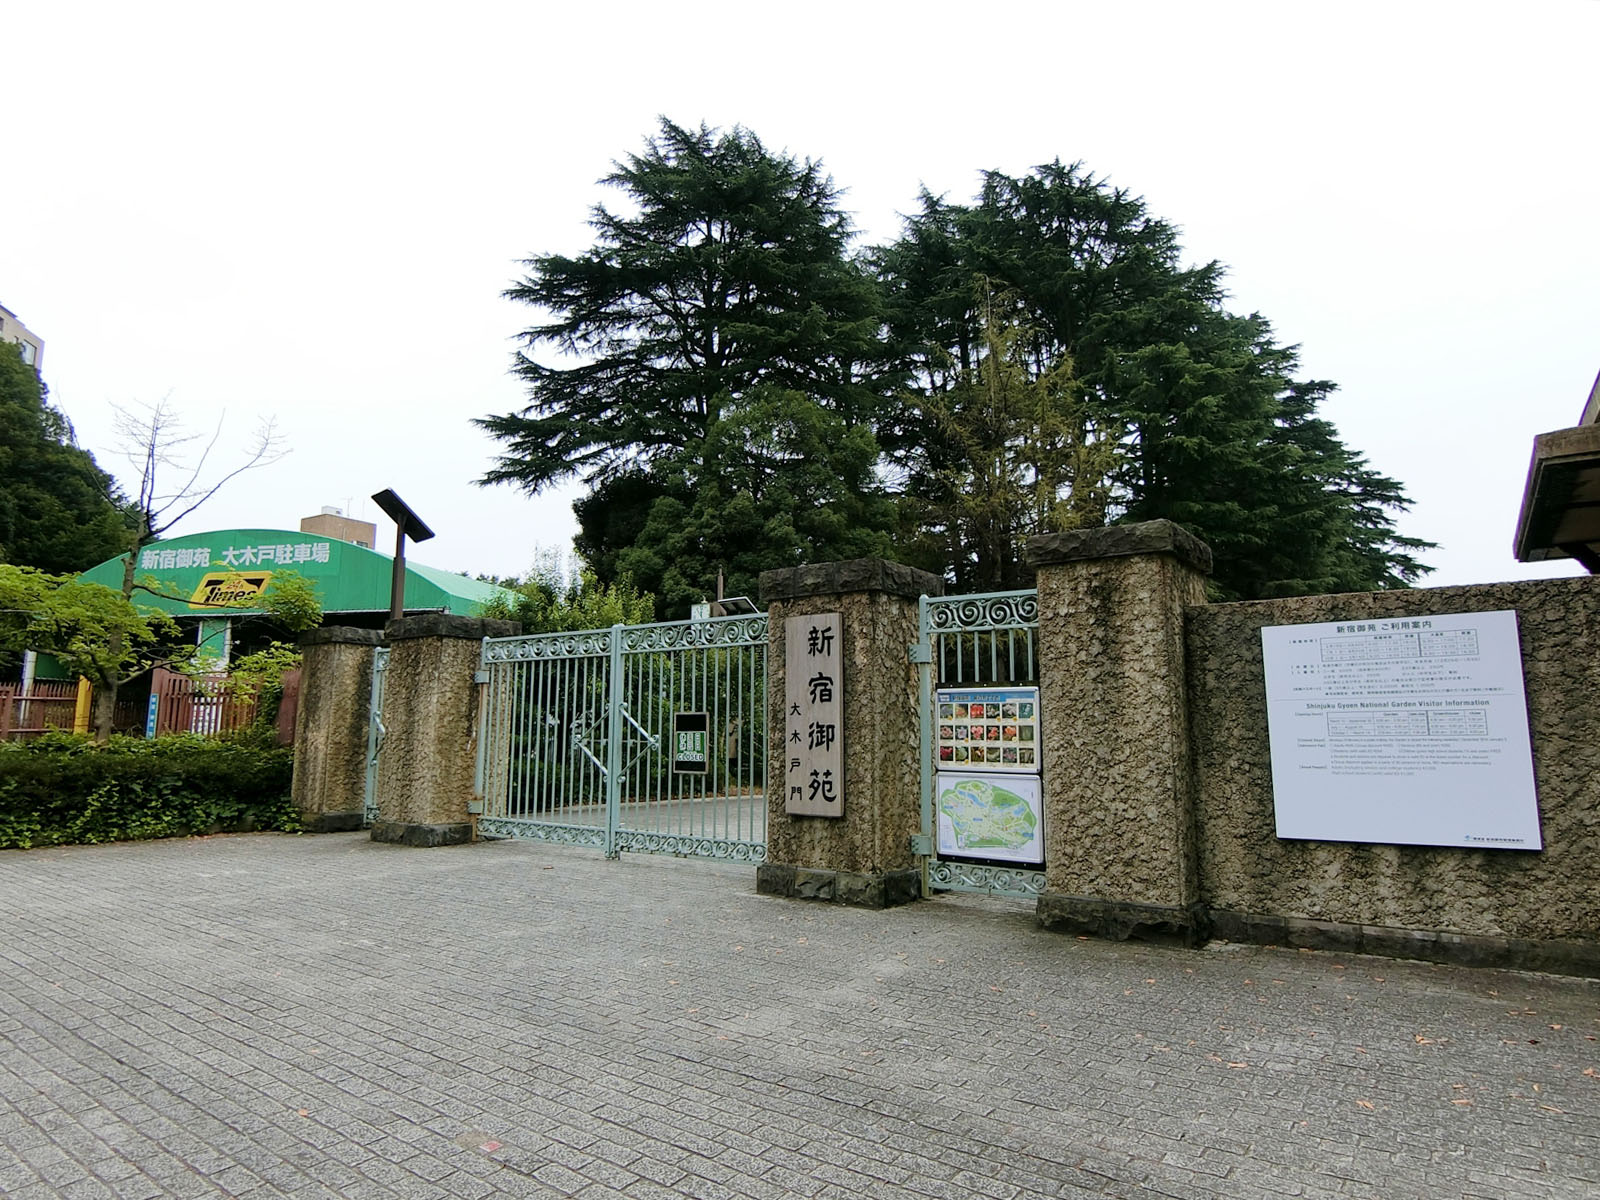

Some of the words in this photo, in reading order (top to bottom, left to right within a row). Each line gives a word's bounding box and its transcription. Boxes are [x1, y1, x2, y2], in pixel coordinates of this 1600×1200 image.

[141, 548, 212, 569] 新宿御苑
[222, 543, 330, 566] 大木戸駐車場
[204, 578, 257, 603] Times
[1336, 624, 1377, 633] 新宿御苑
[1381, 620, 1432, 631] ご利用案内
[808, 626, 837, 803] 新宿御苑
[1306, 703, 1336, 711] Shinjuku
[1337, 702, 1358, 710] Gyoen
[677, 753, 703, 761] CLOSED
[790, 702, 802, 801] 大木戸門
